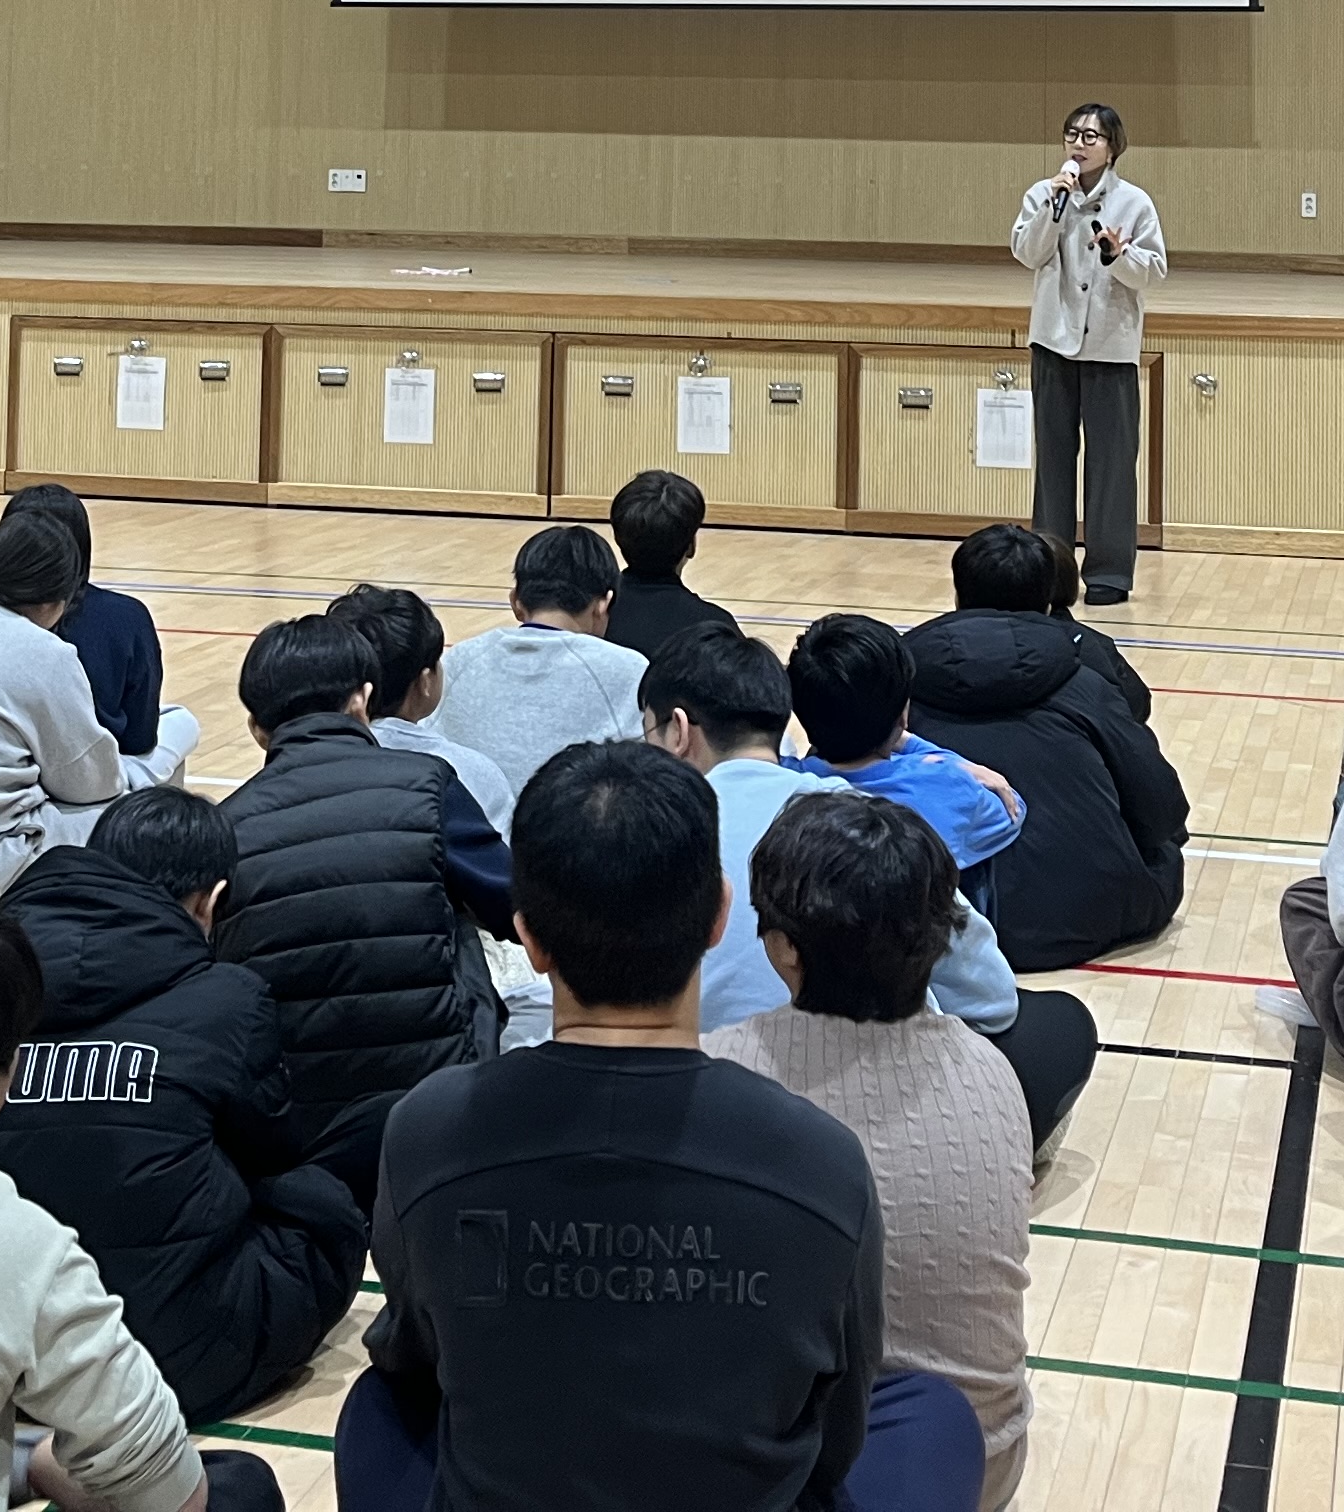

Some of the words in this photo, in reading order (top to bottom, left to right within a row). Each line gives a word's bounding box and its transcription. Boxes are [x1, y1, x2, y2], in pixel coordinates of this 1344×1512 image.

[6, 1041, 159, 1104] UMA
[527, 1220, 721, 1260] NATIONAL
[523, 1262, 770, 1306] GEOGRAPHIC
